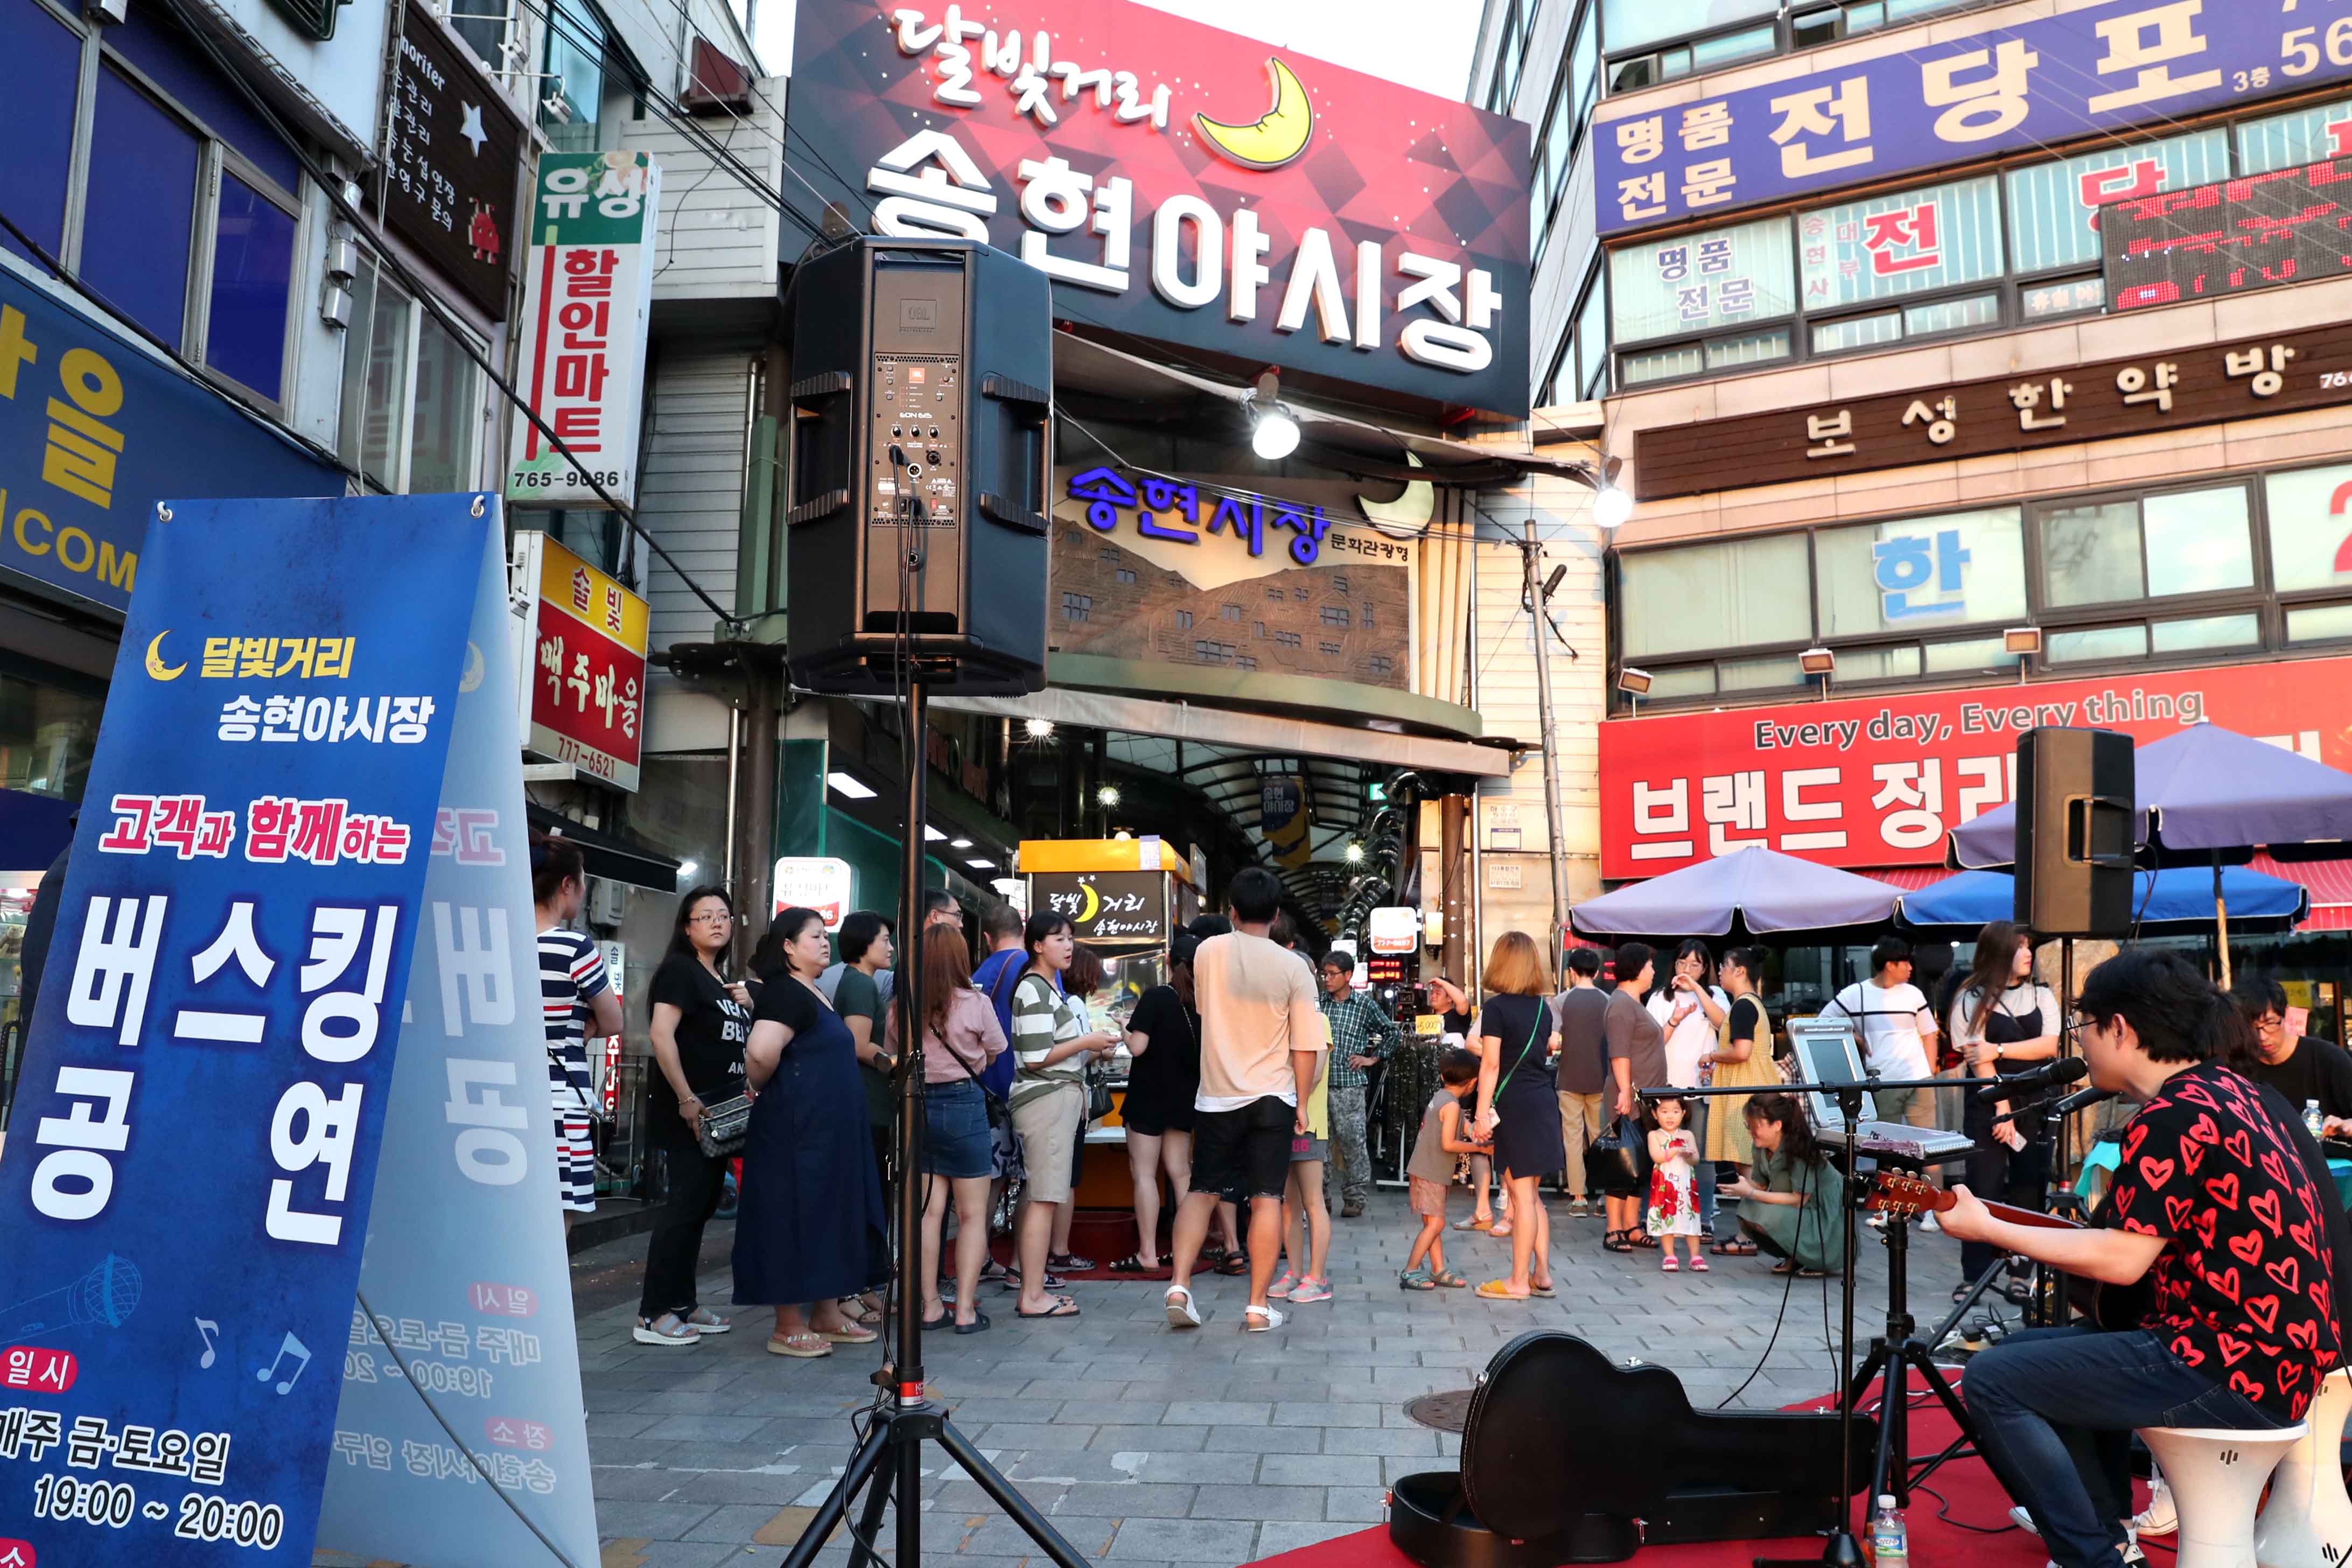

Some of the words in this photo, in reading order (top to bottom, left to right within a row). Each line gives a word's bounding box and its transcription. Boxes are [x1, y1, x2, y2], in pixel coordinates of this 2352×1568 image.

[401, 35, 446, 92] noriter
[892, 5, 1170, 131] 달빛거리
[1768, 2, 2222, 179] 전당포
[2232, 66, 2270, 93] 3층
[1616, 101, 1734, 164] 명품
[386, 156, 425, 204] 반영구
[431, 197, 452, 233] 문의
[432, 169, 456, 206] 연장
[542, 164, 644, 219] 유성
[1617, 158, 1737, 222] 전문
[867, 127, 1502, 373] 송현야시장
[1658, 237, 1732, 283] 명품
[1835, 221, 1861, 279] 대부
[1677, 275, 1756, 323] 전문
[549, 248, 620, 453] 할인마트
[1805, 344, 2297, 461] 보성한약방
[2320, 370, 2352, 389] 76
[514, 470, 619, 488] 765-9086
[1066, 466, 1331, 565] 송현시장
[1331, 533, 1409, 562] 문화관광형
[1870, 528, 1972, 625] 한
[200, 636, 356, 679] 달빛거리
[541, 635, 639, 740] 맥주마을
[218, 696, 435, 744] 송현야시장
[1754, 718, 1860, 751] Every
[1867, 708, 1953, 745] day,
[1960, 701, 2077, 734] Every
[2083, 688, 2204, 724] thing
[558, 736, 616, 780] 777-6521
[98, 793, 236, 859] 고객과
[244, 795, 411, 866] 함께하는
[1630, 767, 1848, 860] 브랜드
[1049, 893, 1082, 916] 달빛
[1102, 893, 1145, 913] 거리
[1093, 918, 1159, 936] 송현야시장
[66, 895, 398, 1063] 버스킹
[31, 1066, 364, 1245] 공연
[8, 1350, 69, 1390] 일시
[68, 1415, 231, 1486] 금·토요일
[34, 1474, 136, 1529] 19:00
[175, 1492, 284, 1551] 20:00
